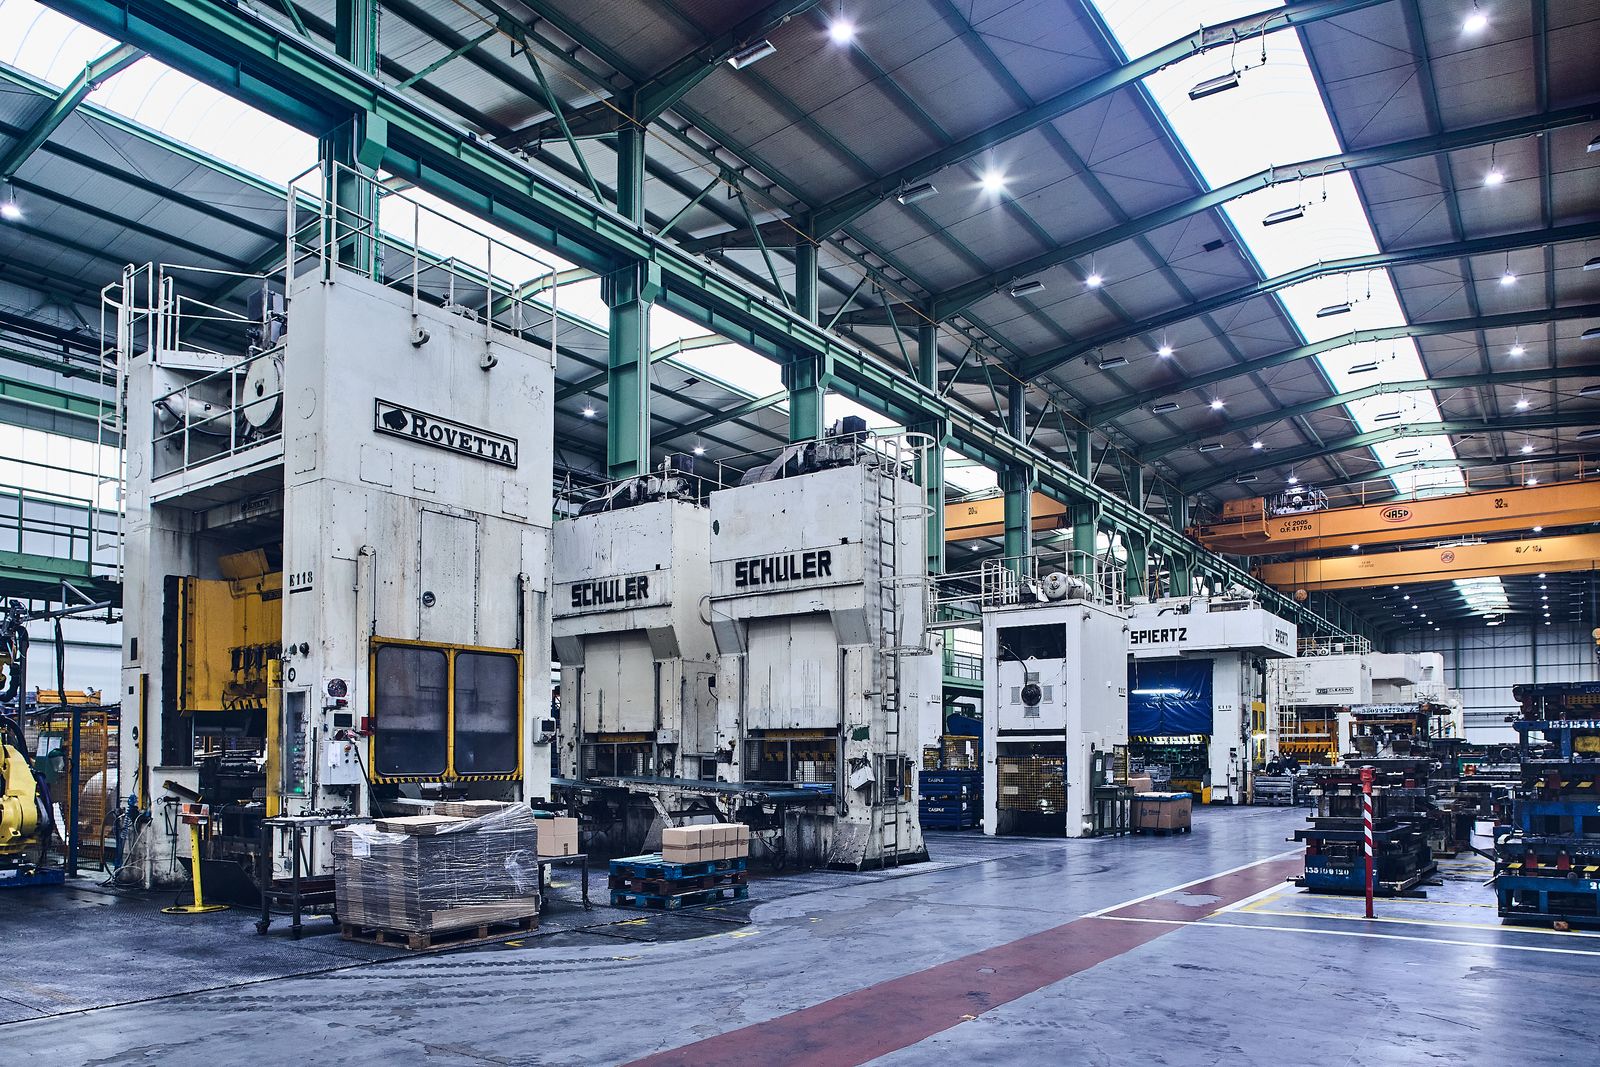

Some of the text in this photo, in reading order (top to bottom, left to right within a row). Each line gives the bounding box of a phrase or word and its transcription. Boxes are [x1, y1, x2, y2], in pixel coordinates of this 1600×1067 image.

[411, 413, 512, 462] ROVETTA
[1292, 524, 1312, 532] 41750
[290, 571, 313, 587] E118
[736, 550, 833, 587] SCHULER
[571, 575, 649, 607] SCHULER
[1130, 627, 1187, 644] SPIERTZ
